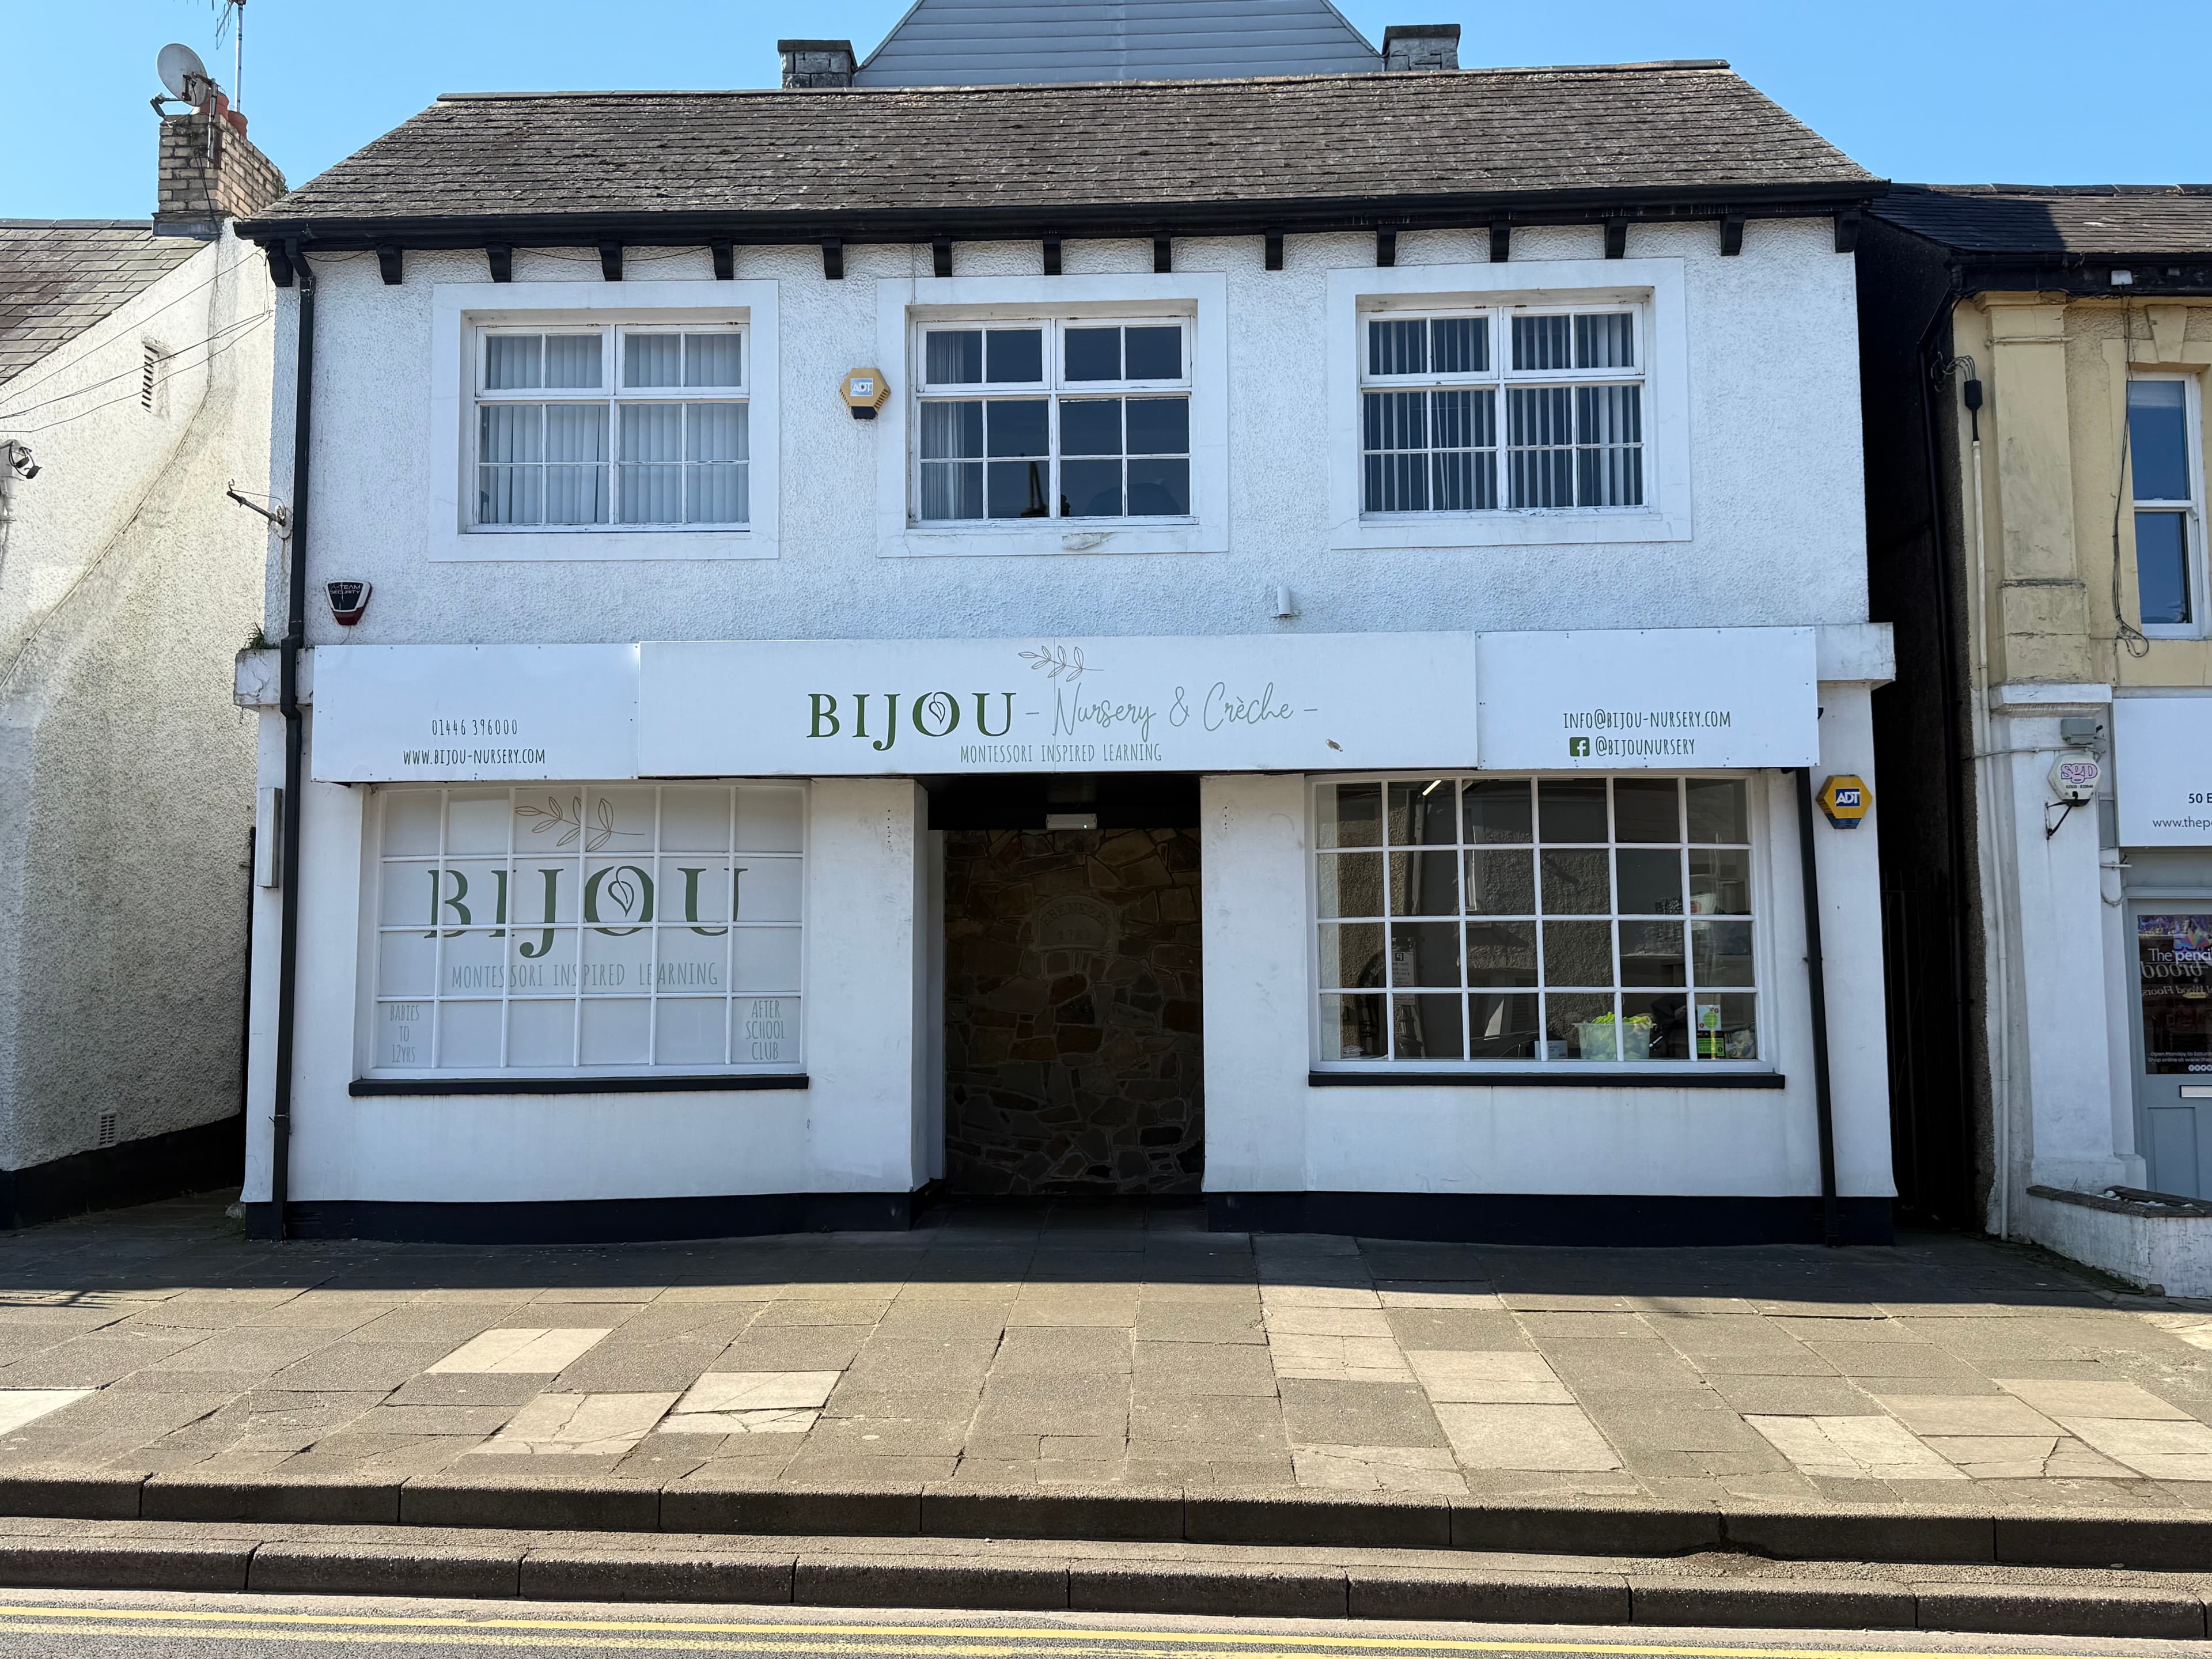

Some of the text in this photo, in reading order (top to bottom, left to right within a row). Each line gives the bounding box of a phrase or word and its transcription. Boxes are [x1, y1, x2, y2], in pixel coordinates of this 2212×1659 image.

[852, 382, 873, 393] ADT
[805, 690, 1018, 752] BIJOU
[1052, 682, 1157, 743] Nursery
[1169, 686, 1190, 727] &
[1203, 681, 1294, 732] Crèche
[1563, 709, 1730, 730] INFO@BIJOU-NURSERY.COM
[433, 719, 517, 736] 01446 396000
[961, 742, 1164, 765] MONTESSORI INSPIRED LEARNING
[1596, 736, 1694, 757] @BIJOUNURSERY
[403, 749, 545, 766] WWW.BIJOU-NURSERY.COM
[1836, 791, 1861, 804] ADT
[2188, 793, 2203, 804] 50
[2152, 816, 2212, 831] www.thep
[423, 865, 749, 959] BIJOU
[2147, 948, 2172, 961] The
[452, 962, 718, 988] MONTESSORI INSPIRED LEARNING
[390, 1004, 419, 1021] BABIES
[751, 999, 780, 1018] AFTER
[399, 1025, 410, 1042] TO
[746, 1020, 785, 1040] SCHOOL
[752, 1041, 779, 1060] CLUB
